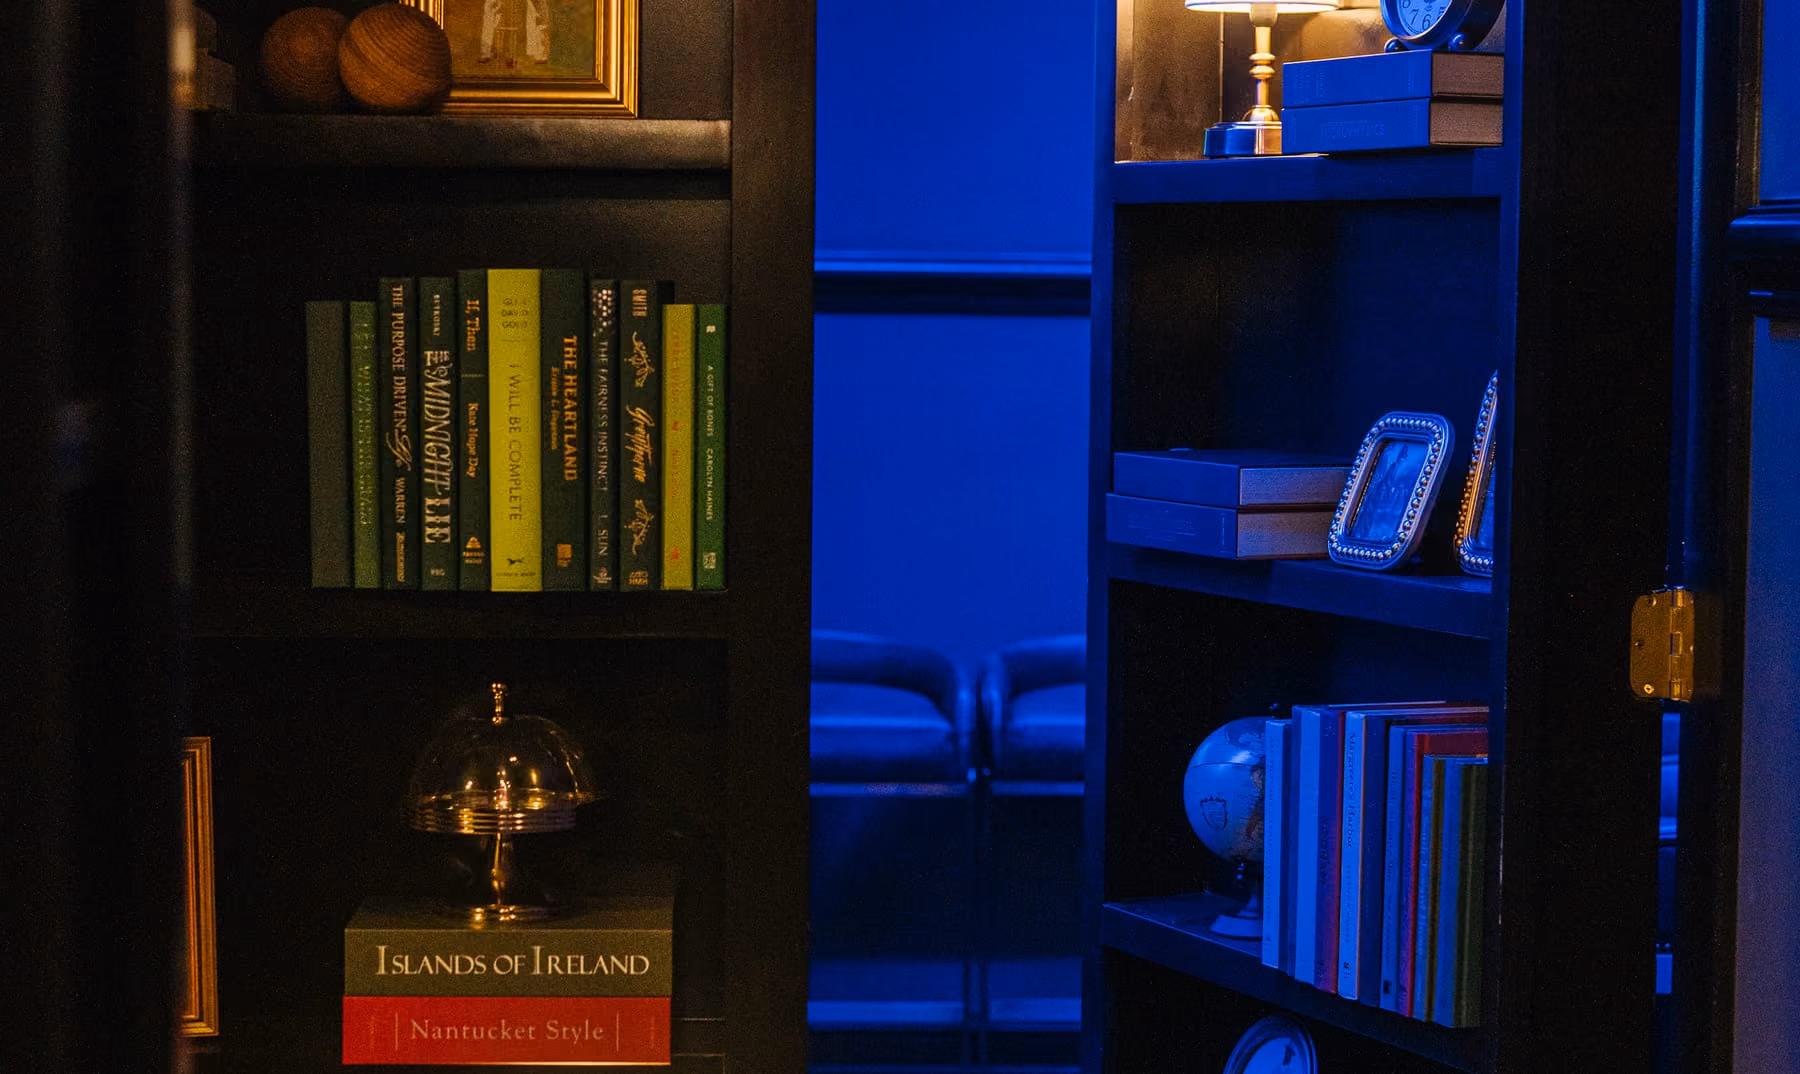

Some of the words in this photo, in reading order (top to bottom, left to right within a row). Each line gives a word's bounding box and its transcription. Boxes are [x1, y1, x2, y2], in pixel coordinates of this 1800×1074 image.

[1409, 8, 1420, 26] 7
[1421, 13, 1432, 31] 6
[392, 285, 403, 308] THE
[465, 298, 480, 314] If,
[632, 288, 647, 317] SMITH
[391, 312, 405, 371] PURPOSE
[466, 317, 481, 352] Then
[564, 336, 578, 369] THE
[598, 340, 608, 363] THE
[508, 374, 522, 412] WILL
[597, 368, 608, 427] FAIRNESS
[706, 395, 713, 406] OF
[468, 402, 479, 426] Kate
[508, 416, 522, 434] BE
[564, 374, 578, 481] HEARTLAND
[424, 364, 453, 495] MIDNIGHT
[466, 428, 479, 457] Hope
[466, 457, 479, 478] Day
[597, 431, 608, 491] INSTINCT
[508, 440, 523, 522] COMPLETE
[394, 477, 406, 524] WARREN
[424, 497, 451, 544] LIE
[376, 945, 487, 976] ISLANDS
[493, 954, 525, 976] OF
[530, 945, 650, 976] IRELAND
[410, 1018, 536, 1040] Nantucket
[546, 1019, 604, 1045] Style
